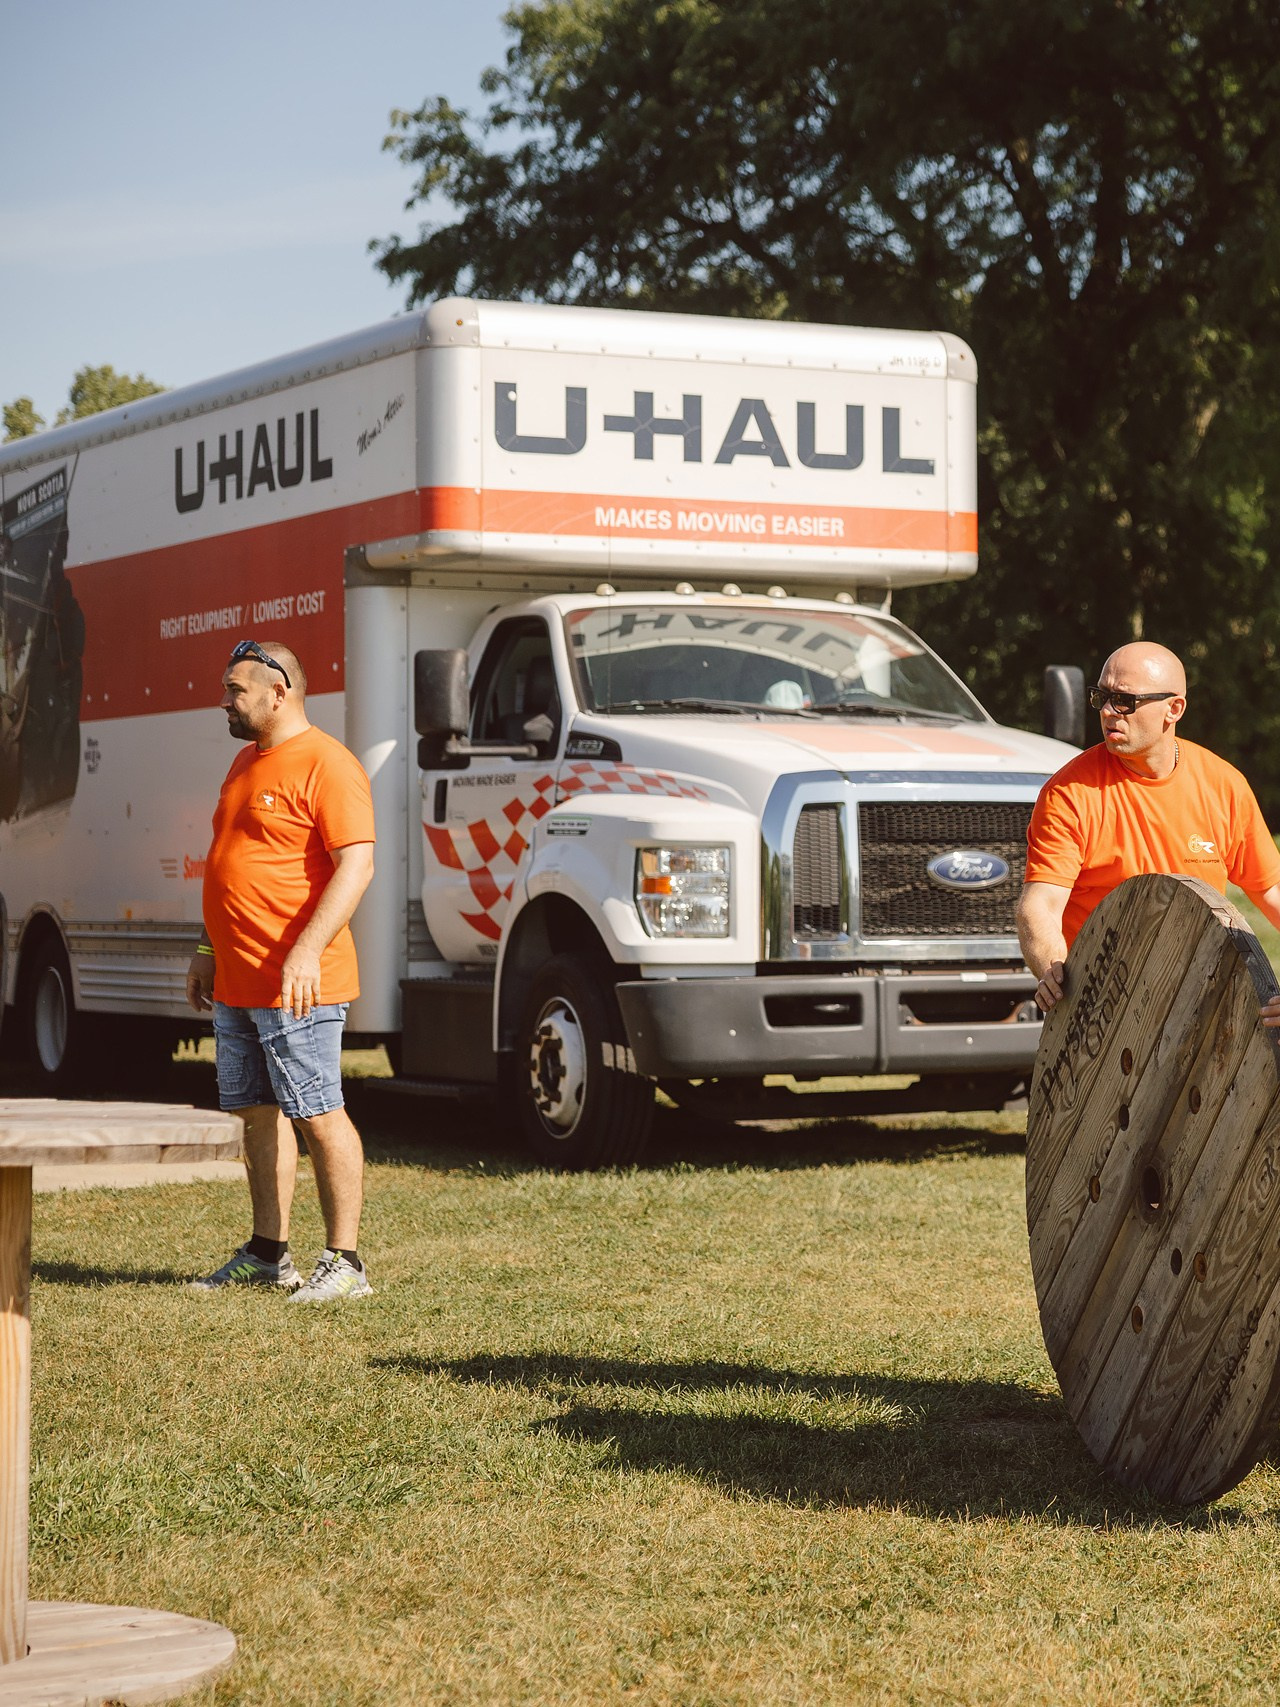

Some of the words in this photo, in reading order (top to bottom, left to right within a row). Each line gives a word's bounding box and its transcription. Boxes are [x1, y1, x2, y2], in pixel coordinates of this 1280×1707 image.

[494, 381, 936, 476] U-HAUL
[175, 407, 333, 514] U-HAUL
[17, 488, 37, 514] NOVA
[38, 472, 64, 502] SCOTIA
[595, 506, 672, 531] MAKES
[677, 510, 766, 535] MOVING
[771, 515, 845, 538] EASIER
[160, 614, 187, 640] RIGHT
[187, 605, 243, 636] EQUIPMENT
[252, 595, 295, 624] LOWEST
[296, 590, 326, 616] COST
[948, 851, 993, 880] Ford
